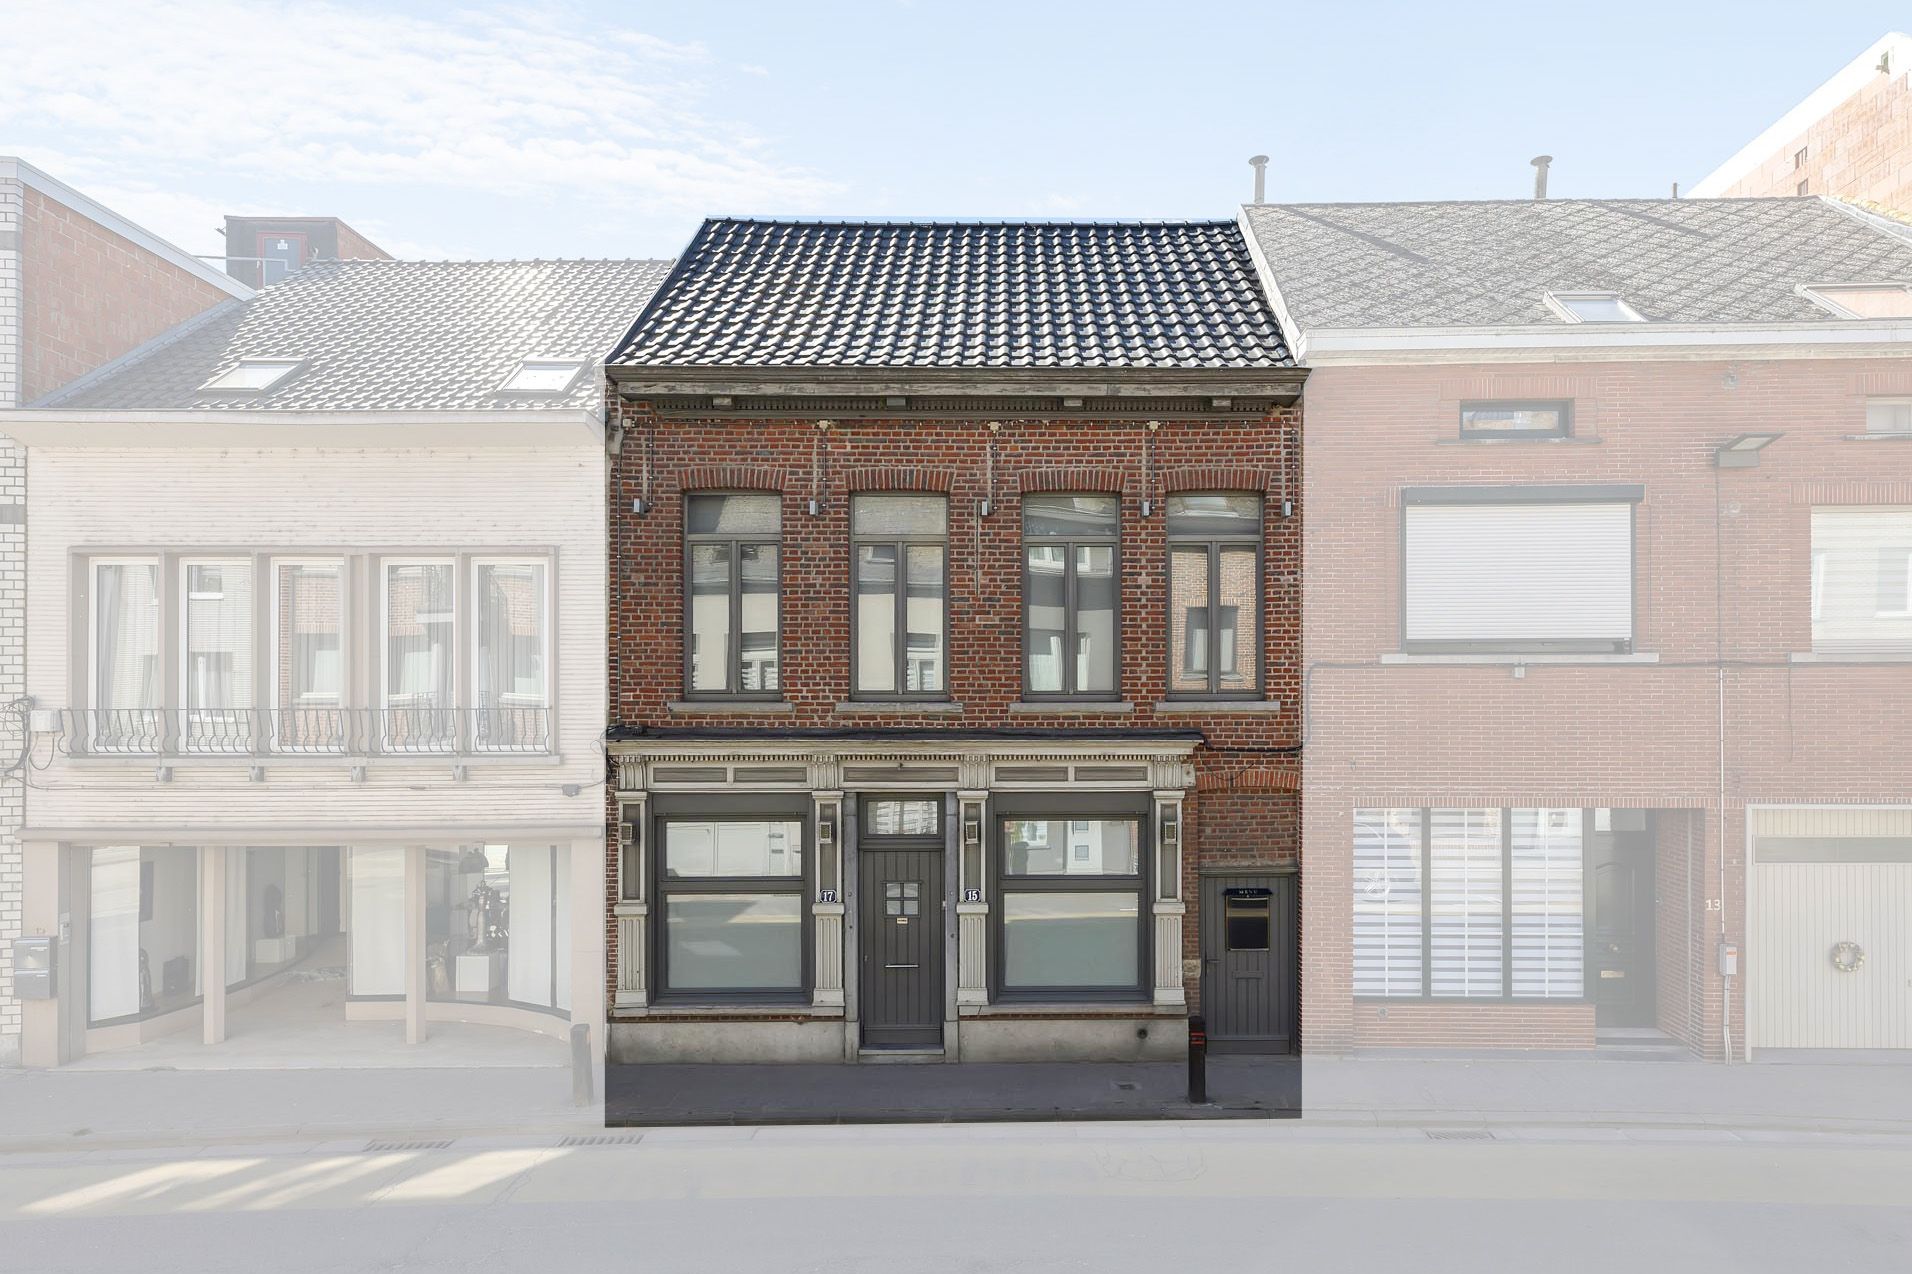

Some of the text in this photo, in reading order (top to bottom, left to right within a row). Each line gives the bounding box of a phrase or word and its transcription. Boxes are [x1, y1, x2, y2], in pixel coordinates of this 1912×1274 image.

[823, 891, 833, 902] 17
[967, 890, 978, 901] 15
[1705, 899, 1720, 911] 13
